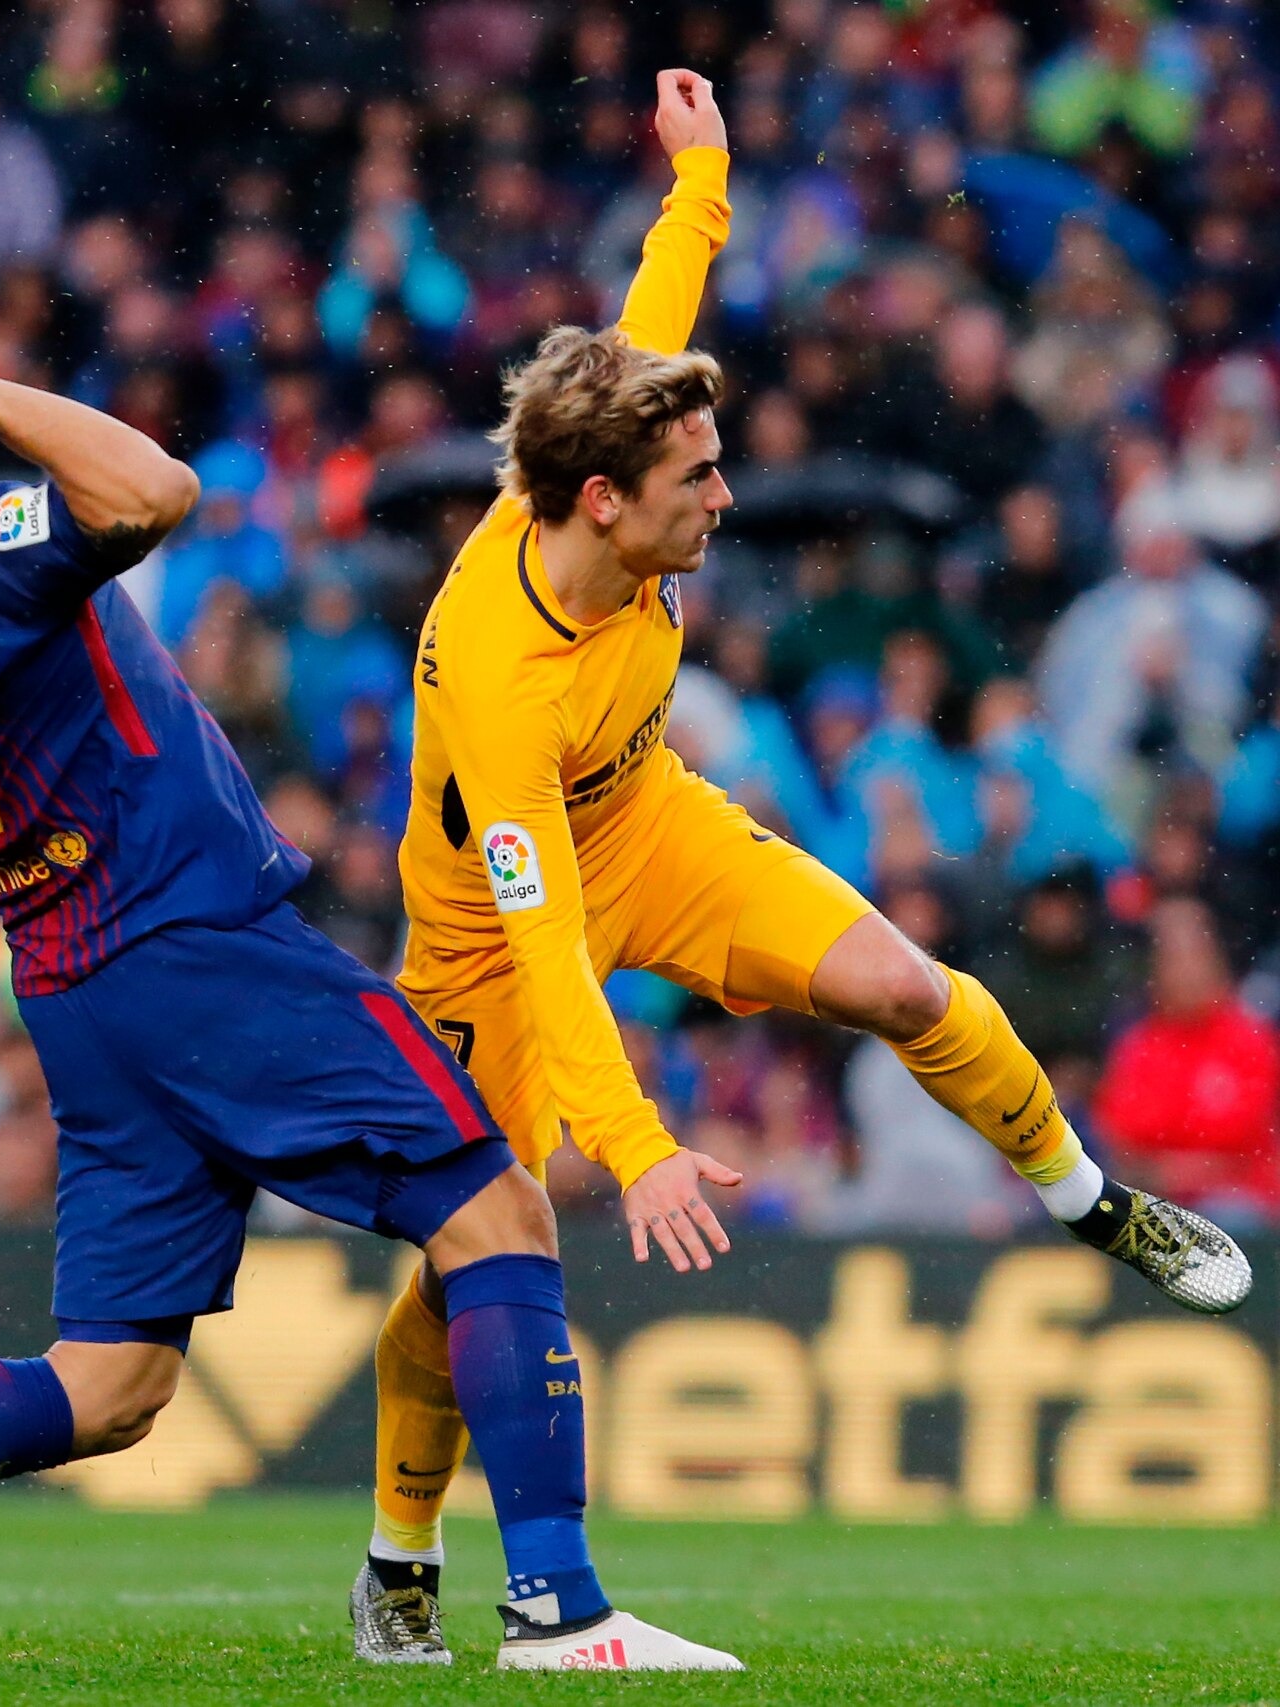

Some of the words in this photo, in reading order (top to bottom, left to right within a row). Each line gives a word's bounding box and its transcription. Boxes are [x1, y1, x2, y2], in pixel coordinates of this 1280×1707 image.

[496, 884, 537, 900] LaLiga
[435, 1018, 476, 1070] 7
[392, 1246, 1272, 1520] etfa
